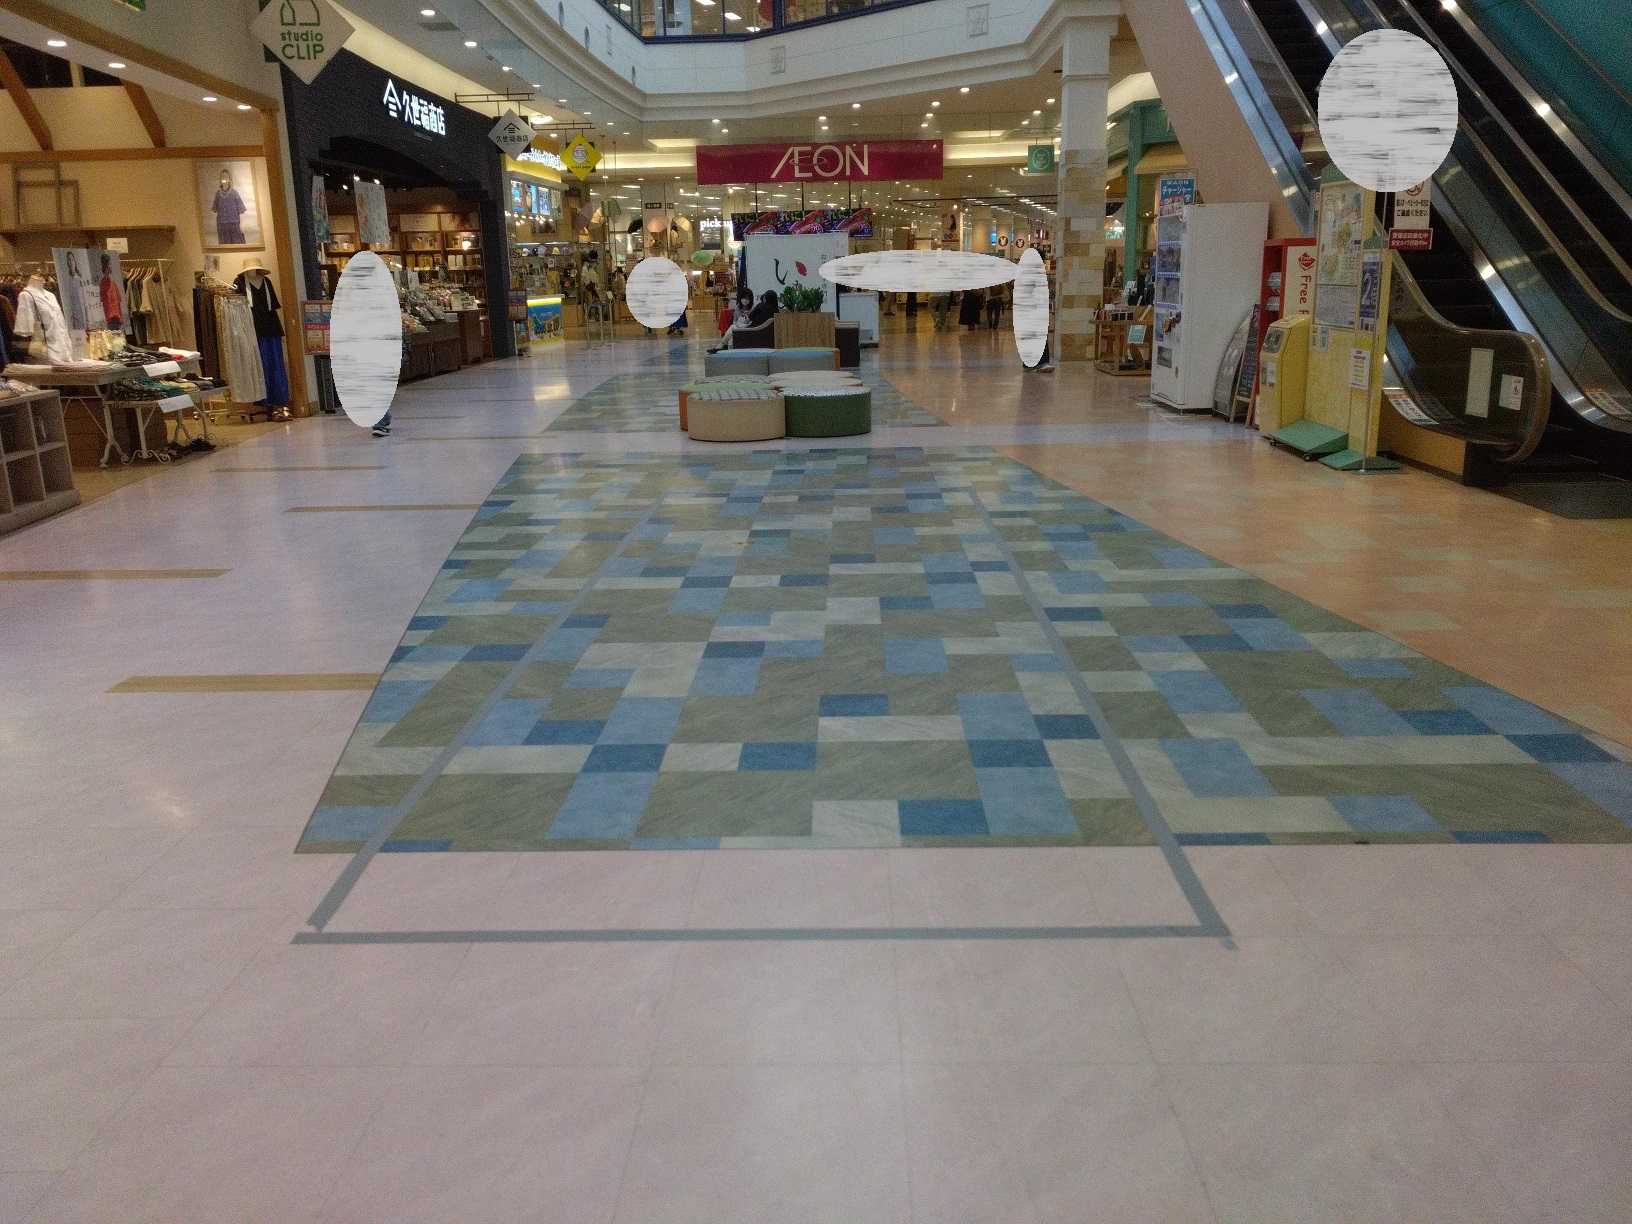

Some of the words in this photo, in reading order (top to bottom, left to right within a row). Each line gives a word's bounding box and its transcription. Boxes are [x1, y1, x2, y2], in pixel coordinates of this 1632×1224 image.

[281, 30, 323, 41] studio
[282, 43, 324, 60] CLIP
[403, 91, 446, 135] 久世福商店
[700, 218, 721, 231] pick
[1300, 275, 1312, 304] Free
